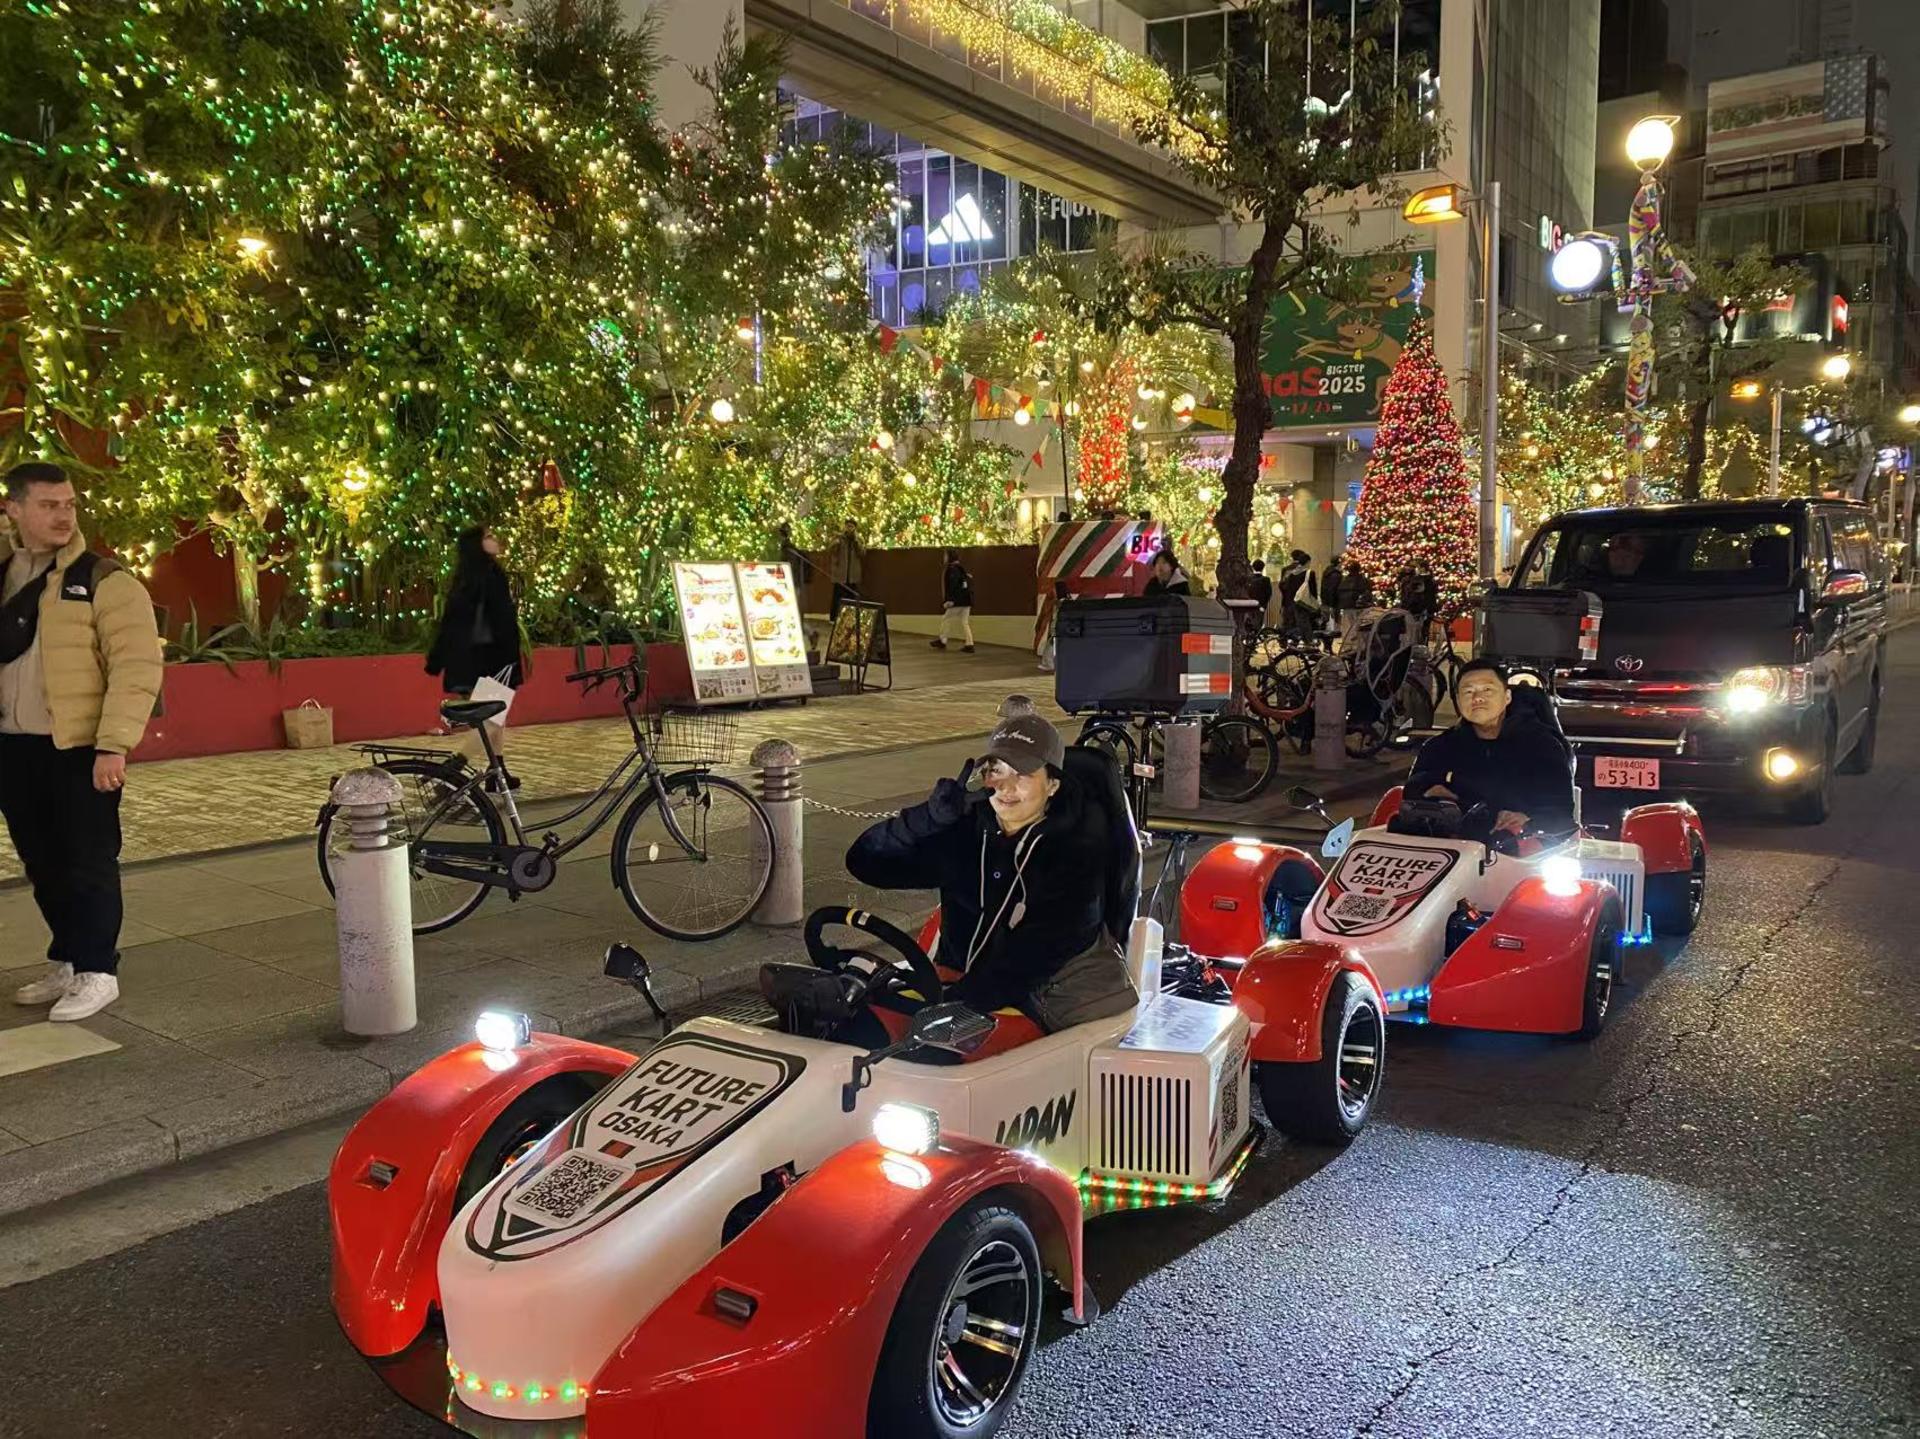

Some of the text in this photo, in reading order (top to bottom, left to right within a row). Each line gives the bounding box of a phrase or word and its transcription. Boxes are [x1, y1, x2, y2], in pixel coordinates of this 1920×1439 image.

[1326, 363, 1366, 376] BIGSTEP
[1319, 376, 1366, 396] 2025
[1608, 769, 1656, 787] 53-13
[1353, 852, 1442, 871] FUTURE
[1350, 875, 1410, 890] OSAKA
[1354, 864, 1425, 882] KART
[637, 1059, 767, 1106] FUTURE
[618, 1085, 725, 1128] KART
[597, 1111, 685, 1148] OSAKA
